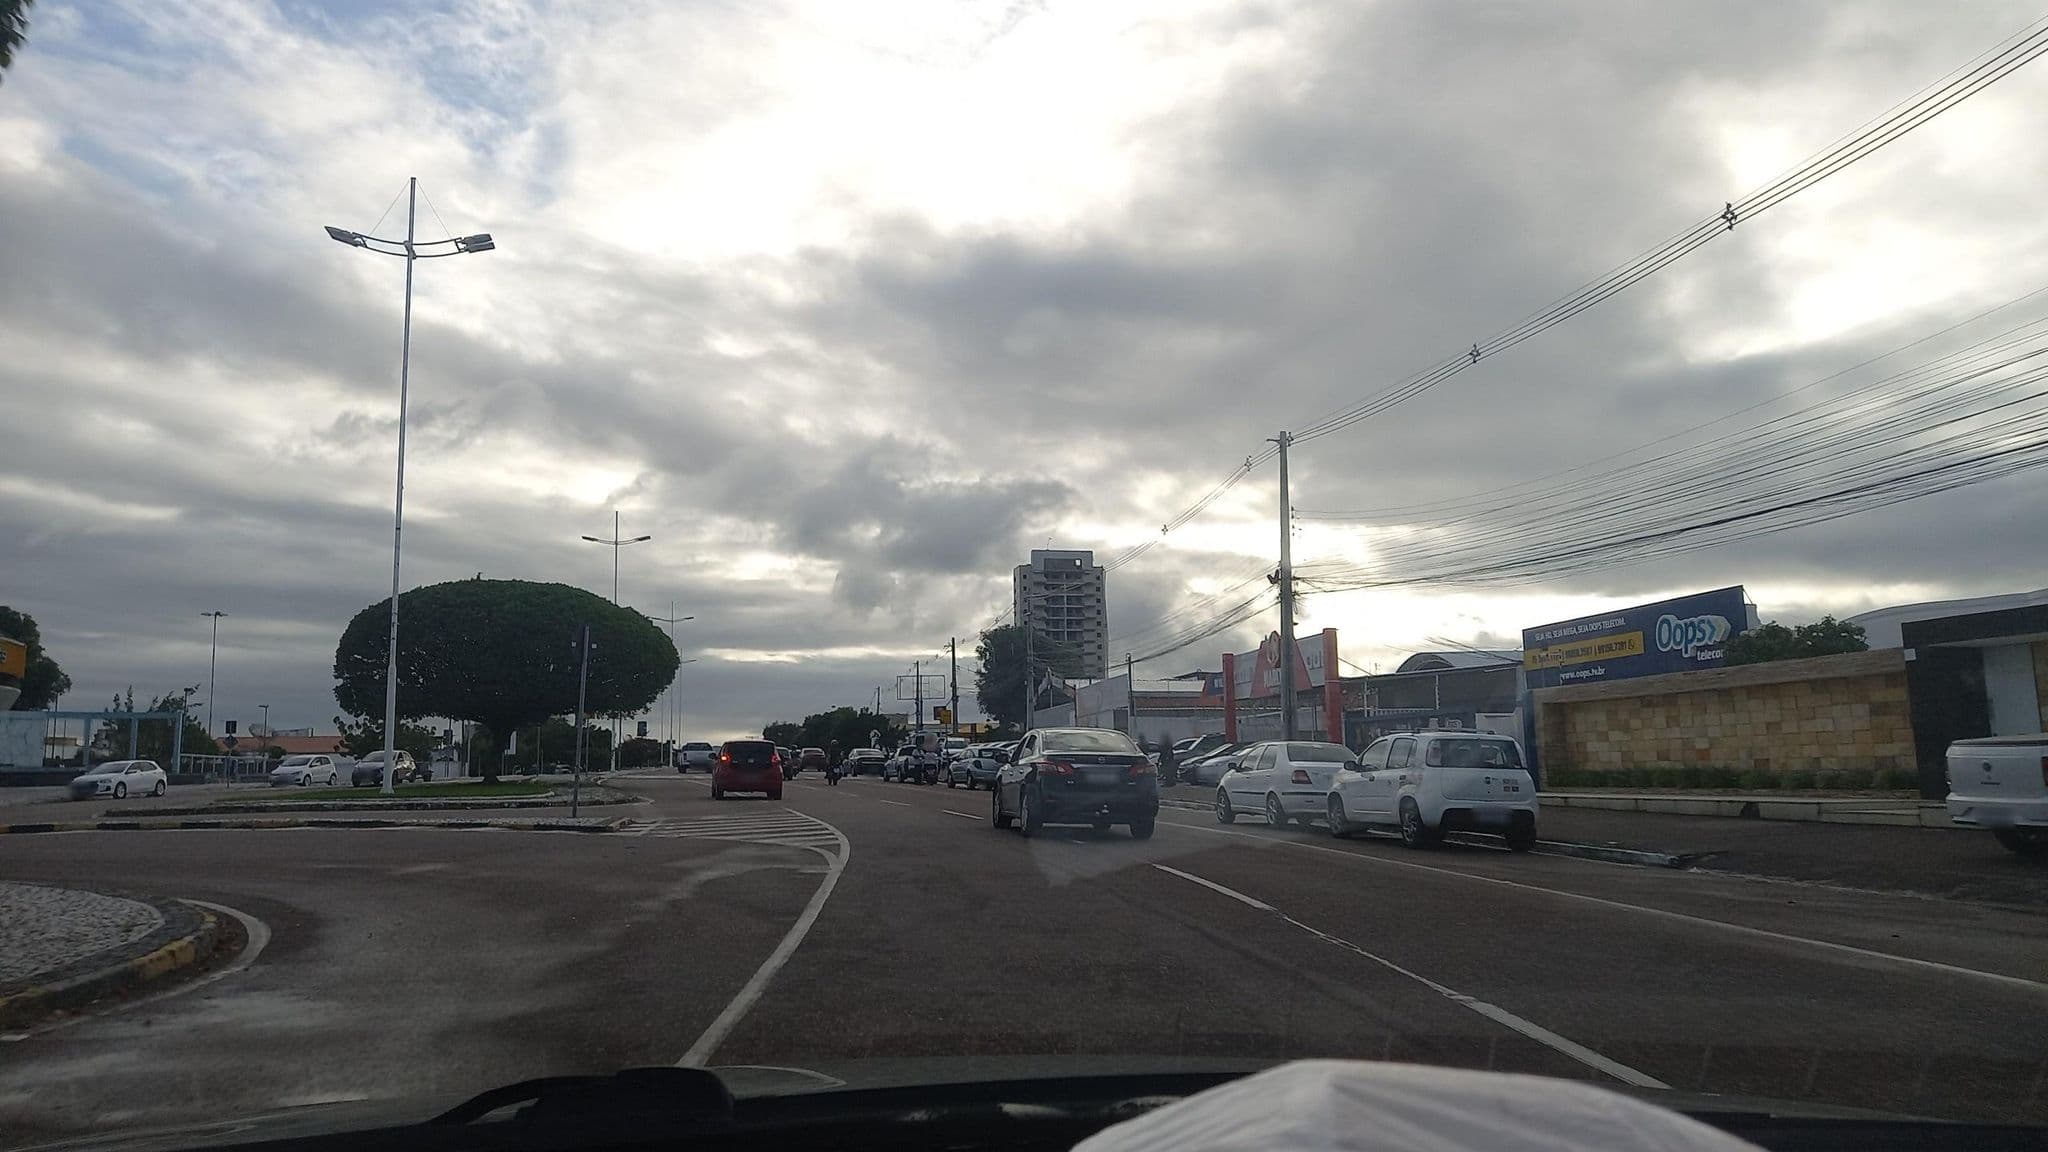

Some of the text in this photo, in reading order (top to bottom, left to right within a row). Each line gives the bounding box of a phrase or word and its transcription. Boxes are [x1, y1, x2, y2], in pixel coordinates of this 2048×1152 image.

[1588, 621, 1601, 631] OOPS
[1656, 616, 1708, 657] Oops
[1697, 648, 1724, 661] teleco
